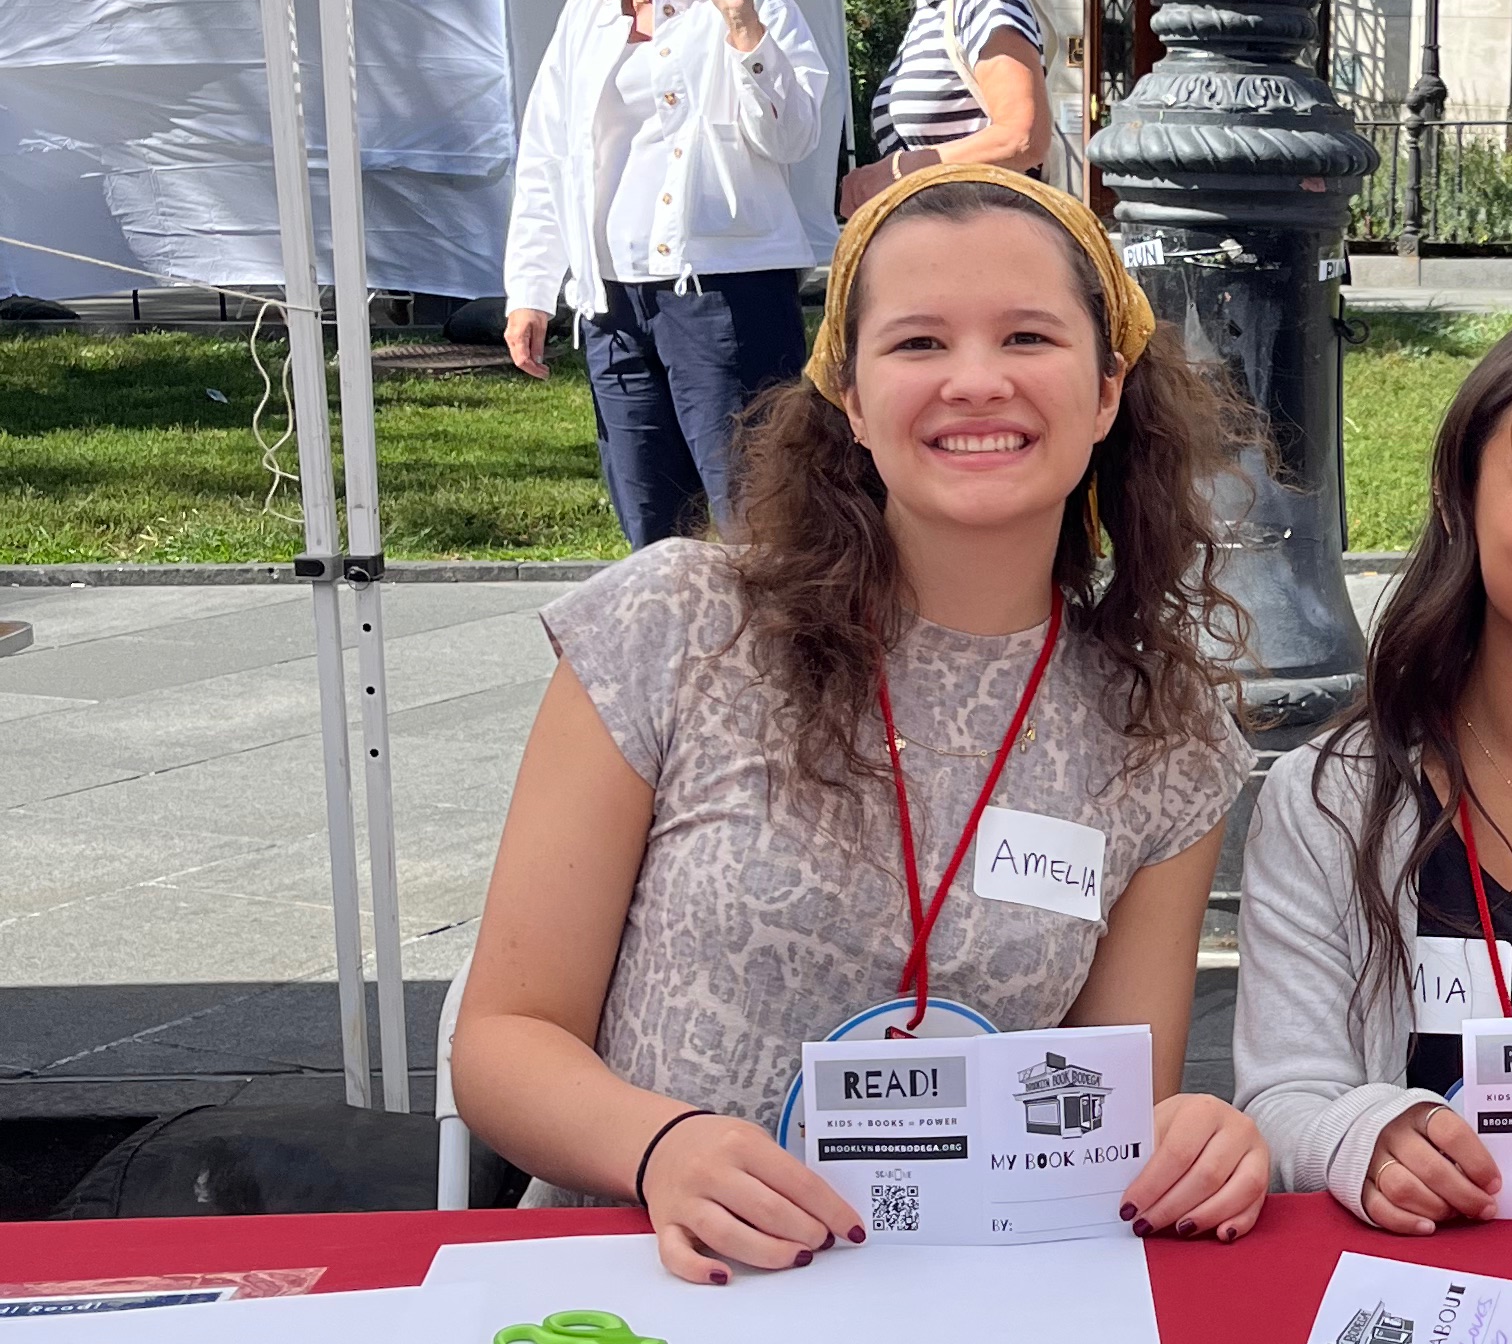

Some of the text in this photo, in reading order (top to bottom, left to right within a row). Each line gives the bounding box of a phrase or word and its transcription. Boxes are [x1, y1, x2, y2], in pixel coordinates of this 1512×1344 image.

[844, 1068, 938, 1100] READ!
[1486, 1093, 1511, 1101] KIDS
[827, 1119, 853, 1128] KIDS
[868, 1119, 904, 1127] BOOKS
[919, 1118, 957, 1126] POWER
[991, 1142, 1141, 1171] MY BOOK ABOUT
[991, 1218, 1013, 1232] BY:
[28, 1303, 102, 1313] Read!
